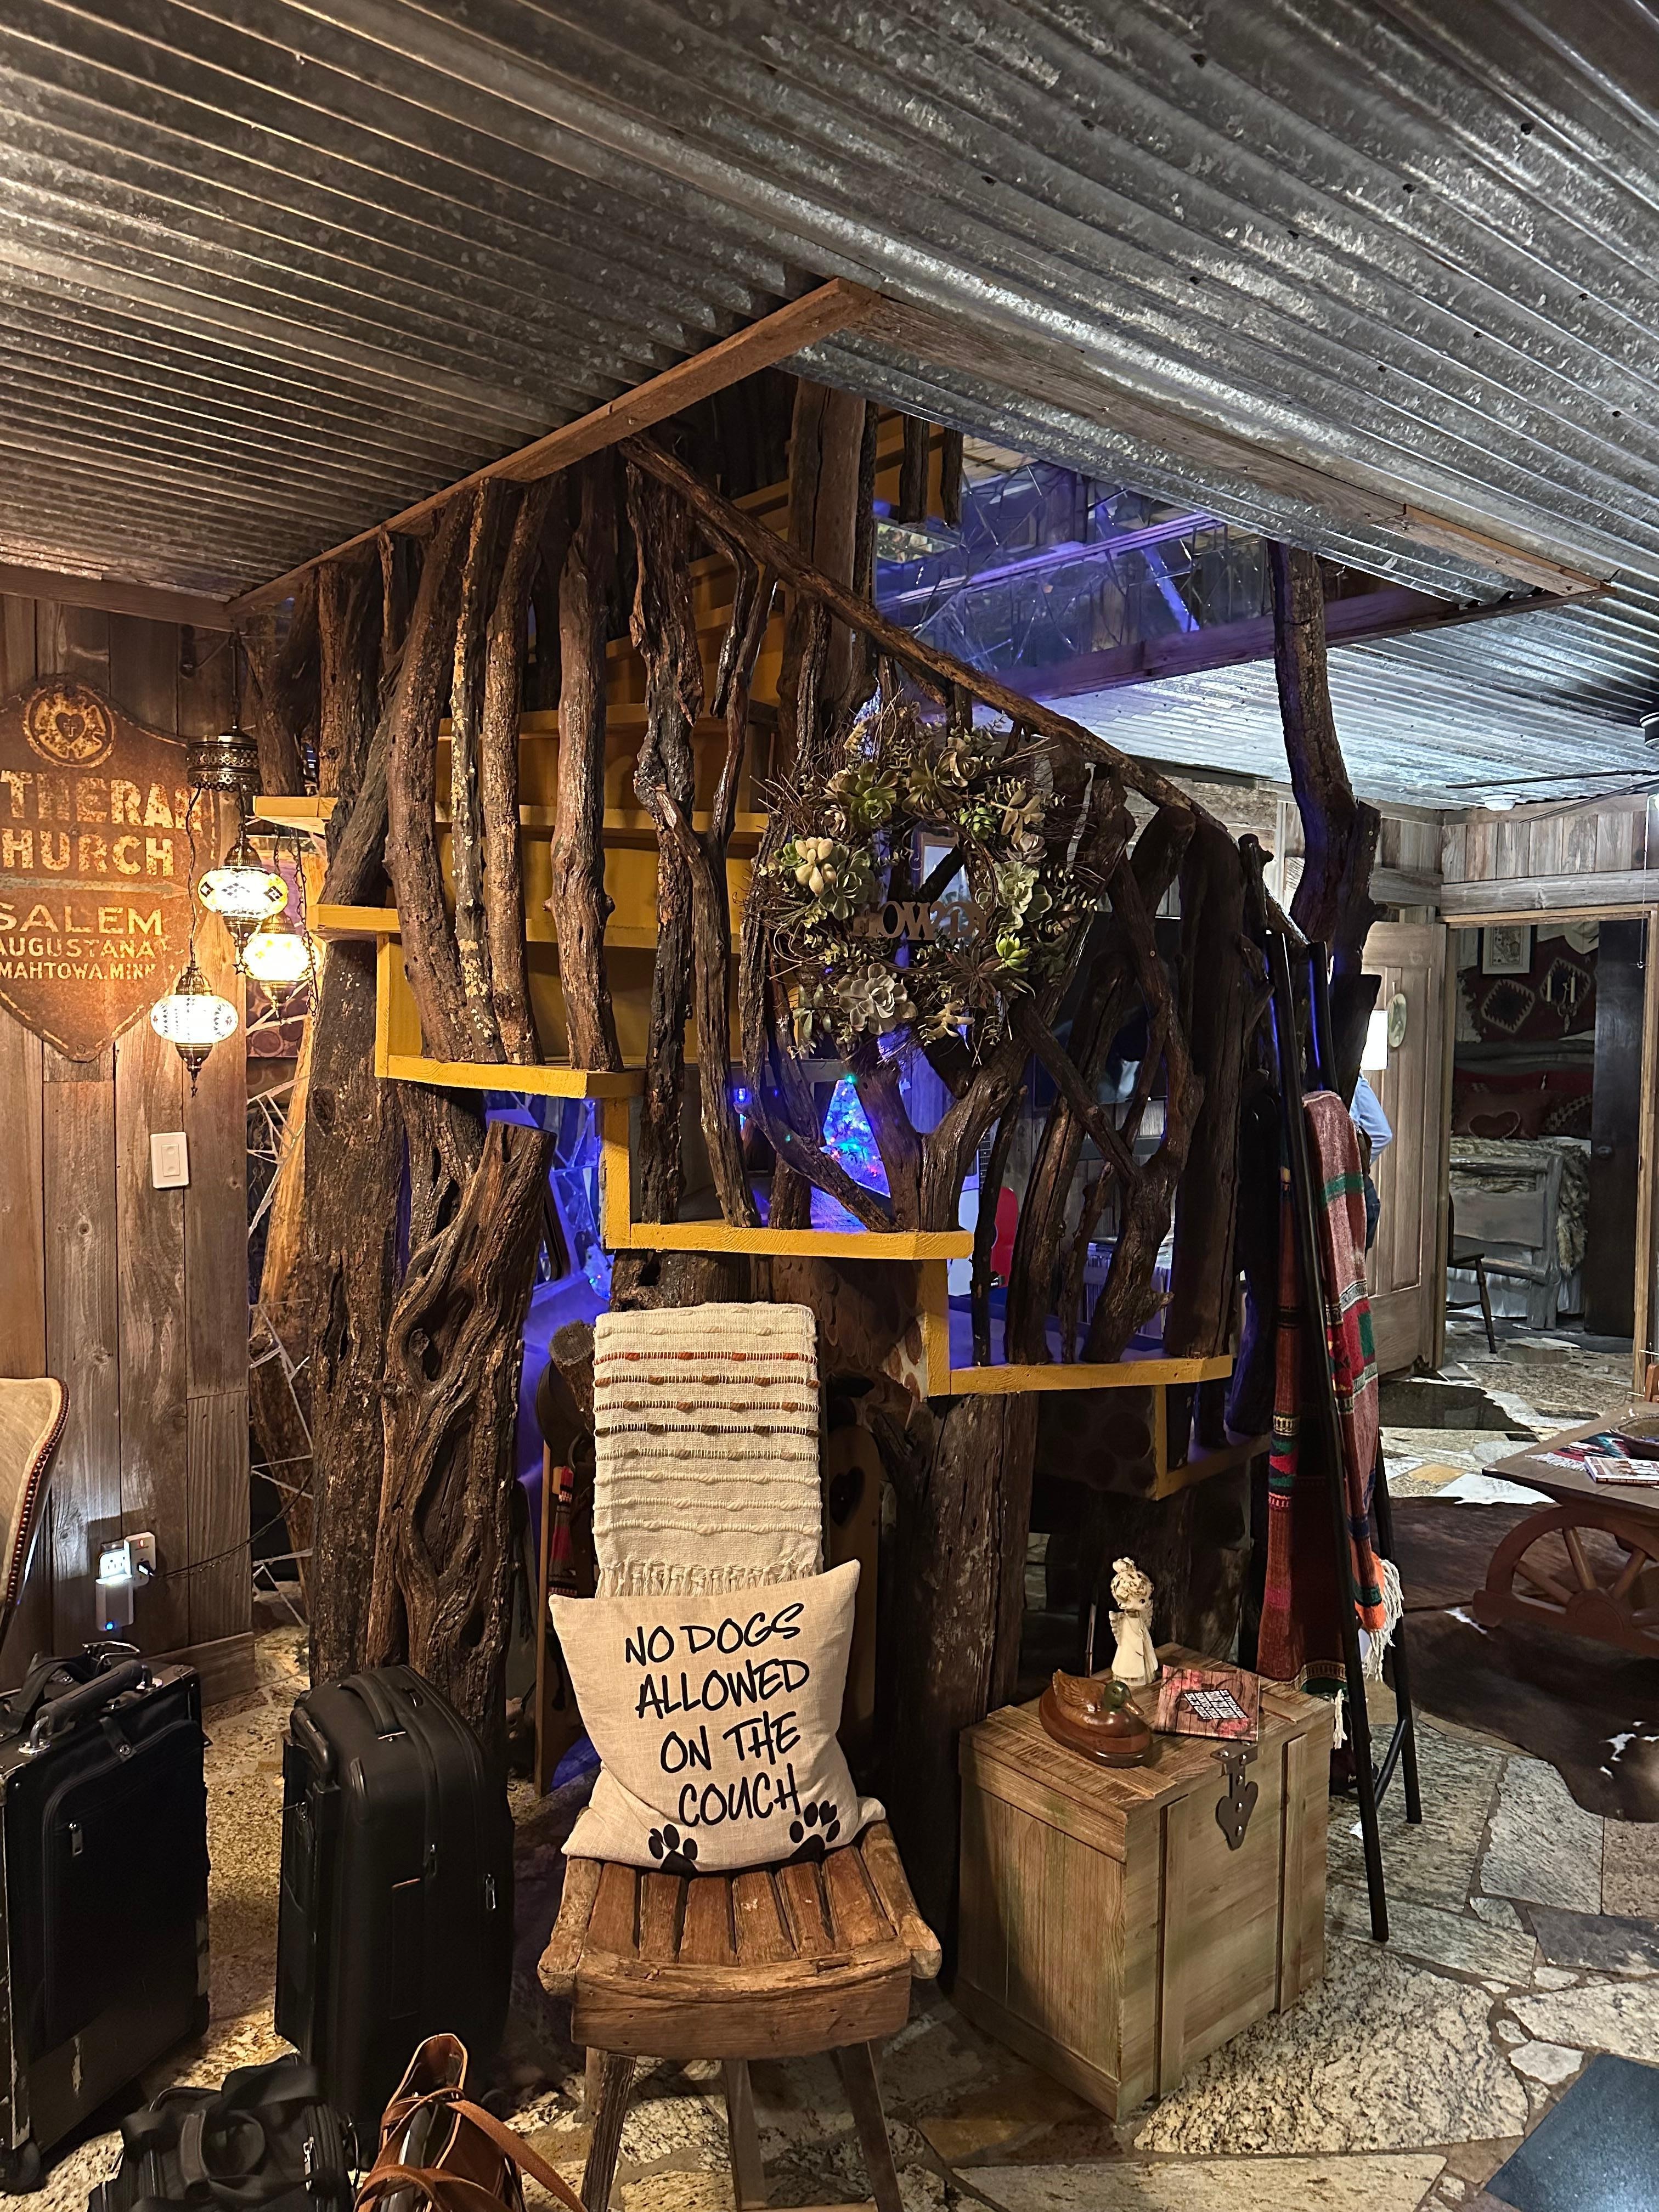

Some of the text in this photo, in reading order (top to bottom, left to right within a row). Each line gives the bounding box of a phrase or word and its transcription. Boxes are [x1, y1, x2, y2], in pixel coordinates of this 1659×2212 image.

[2, 827, 174, 877] HURCH
[0, 902, 162, 936] SALEM
[624, 1602, 804, 1667] NO DOGS
[635, 1658, 810, 1719] ALLOWED
[660, 1710, 801, 1774] ON THE
[679, 1763, 802, 1827] COUCH
